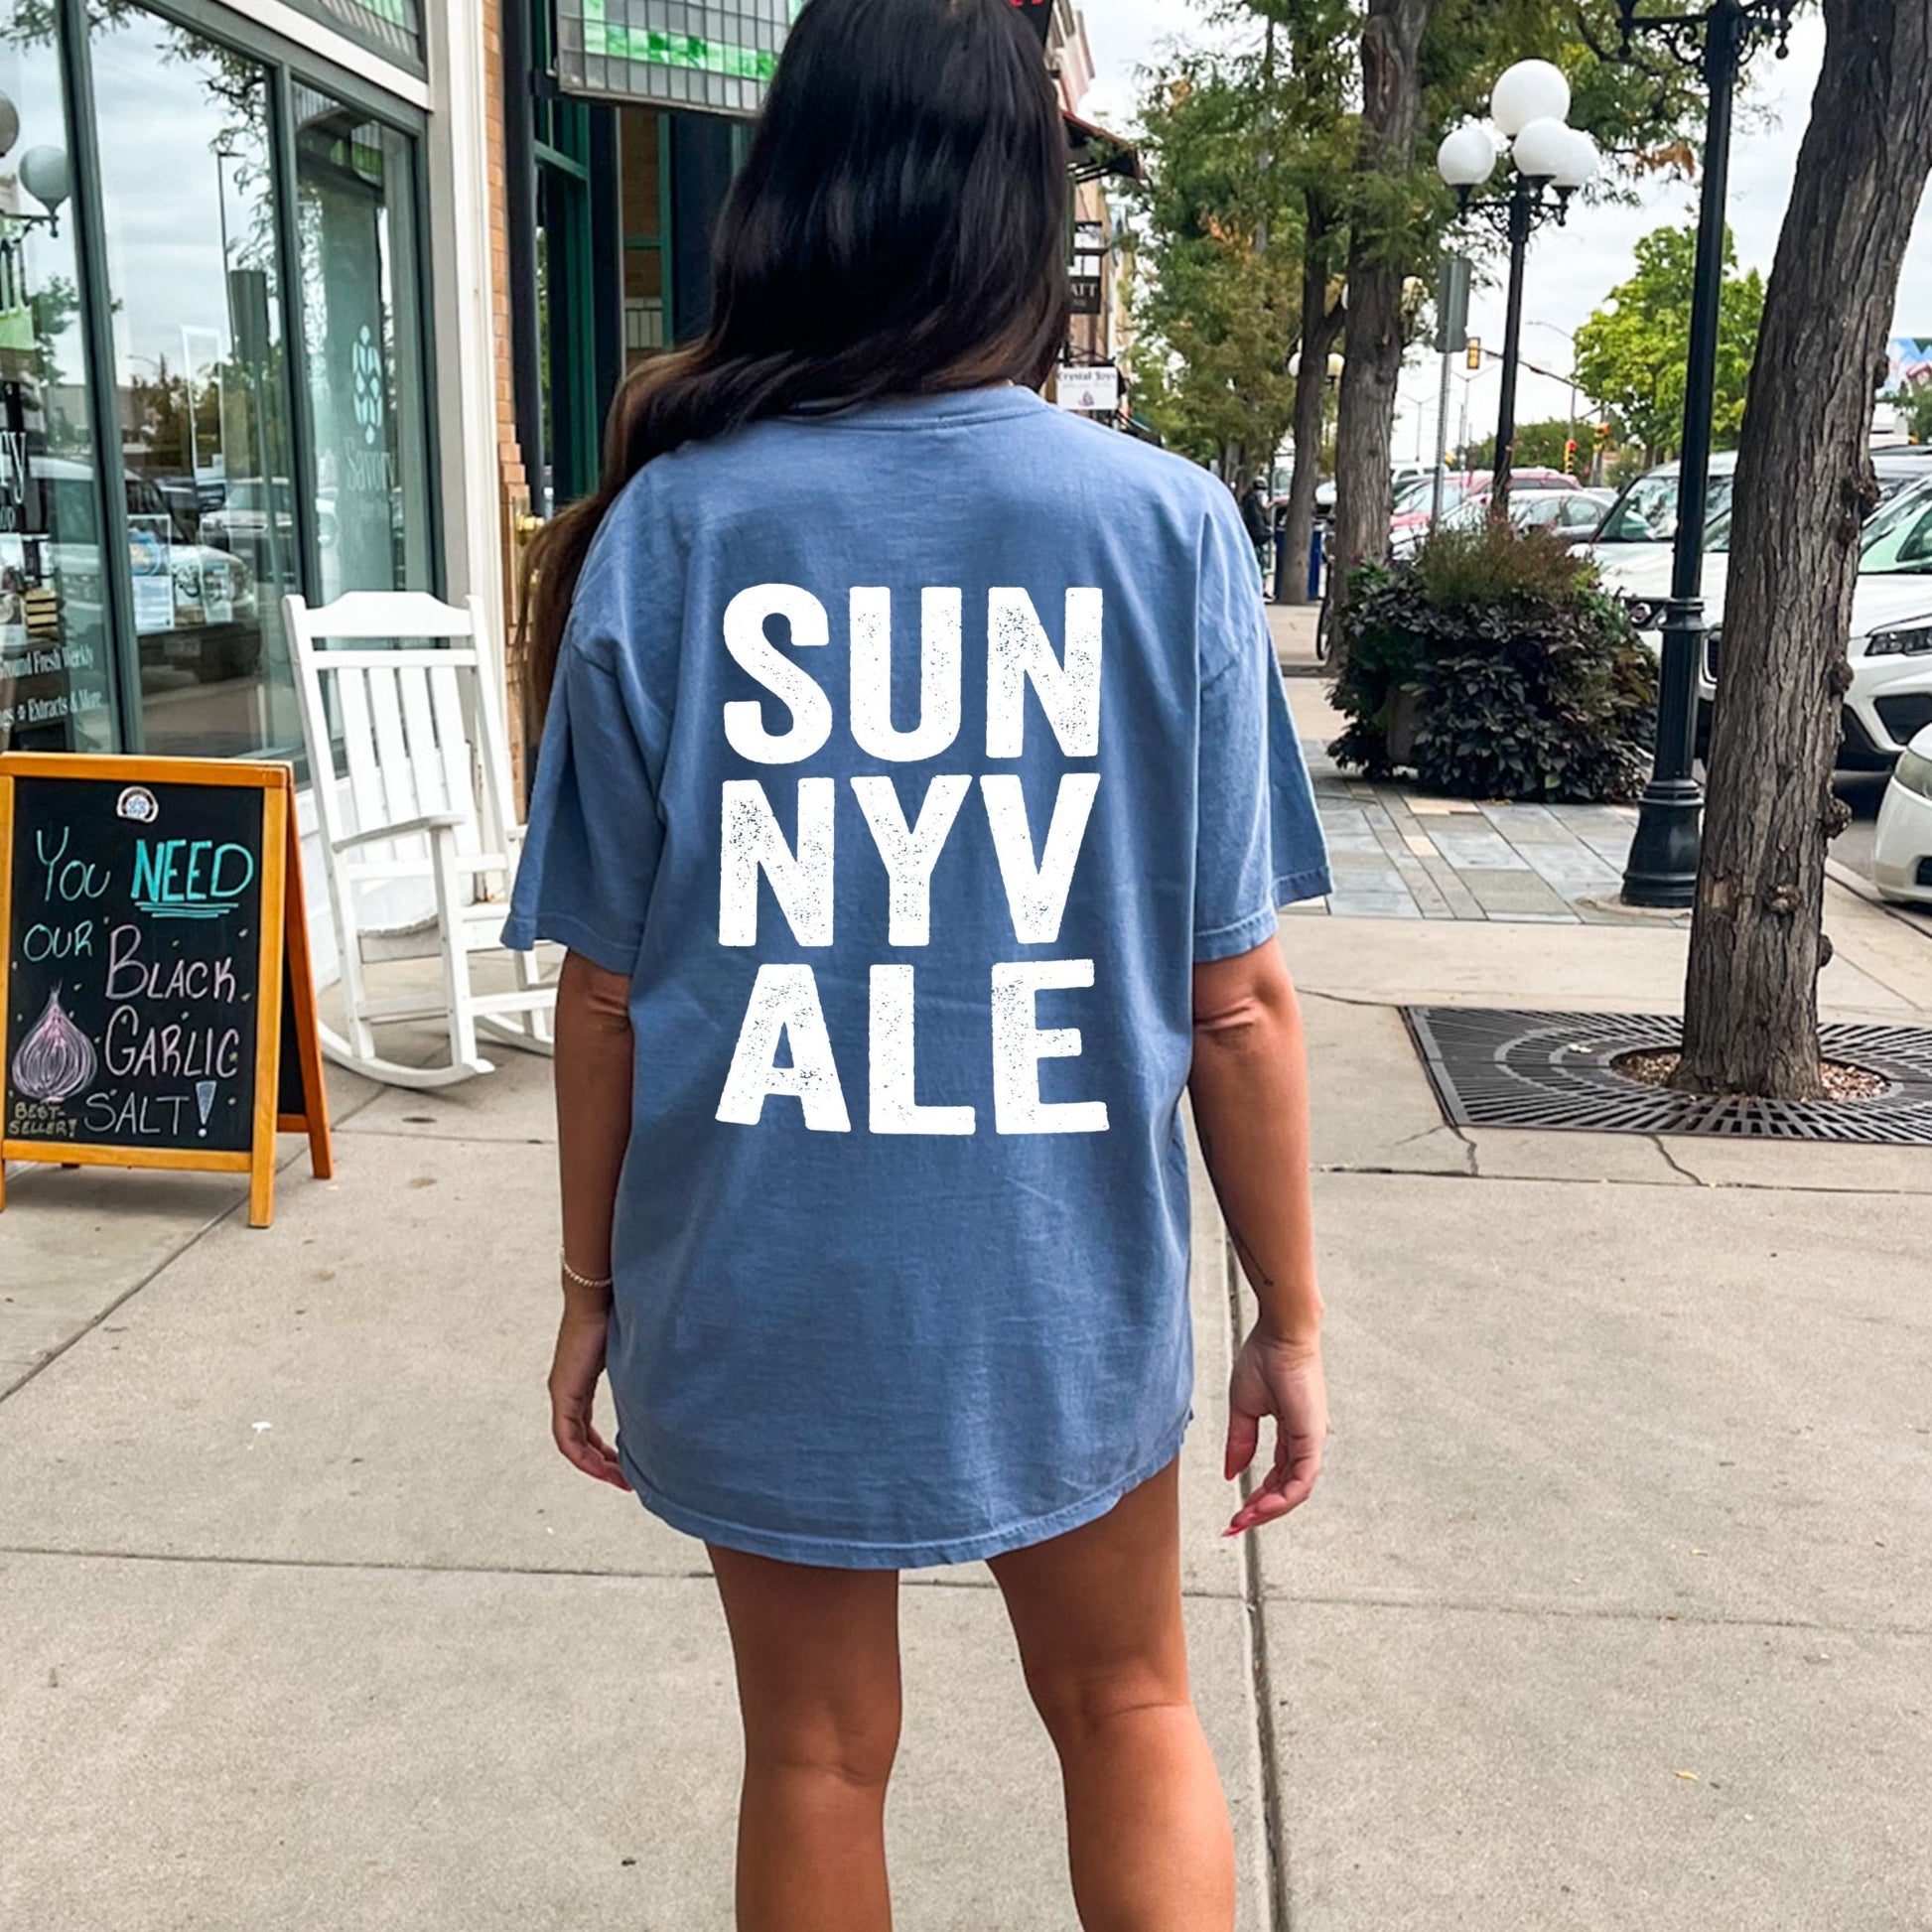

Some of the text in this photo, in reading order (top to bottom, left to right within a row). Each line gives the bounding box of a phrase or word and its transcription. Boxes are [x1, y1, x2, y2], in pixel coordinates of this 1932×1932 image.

[28, 696, 69, 723] Extracts
[723, 583, 1103, 764] SUN
[130, 839, 254, 902] NEED
[718, 772, 1101, 947] NYV
[24, 919, 93, 962] OUR
[105, 924, 236, 1003] BLACK
[105, 1005, 240, 1077] GARLIC
[715, 958, 1110, 1136] ALE
[84, 1080, 217, 1138] SALT!
